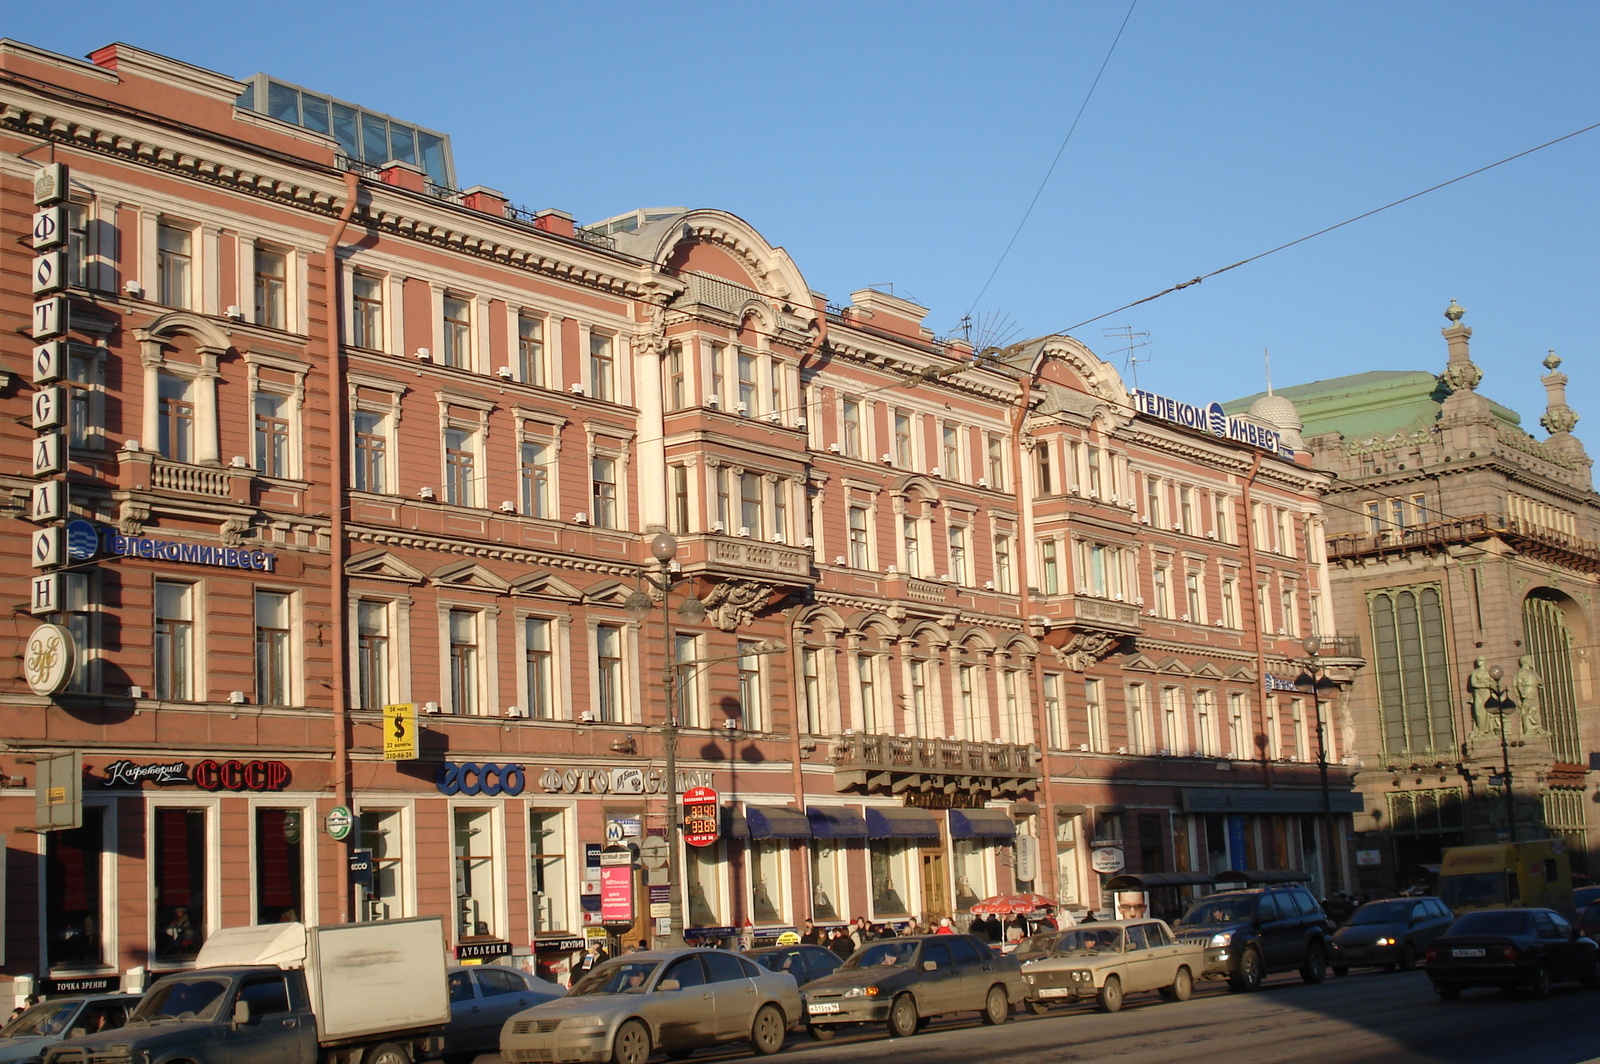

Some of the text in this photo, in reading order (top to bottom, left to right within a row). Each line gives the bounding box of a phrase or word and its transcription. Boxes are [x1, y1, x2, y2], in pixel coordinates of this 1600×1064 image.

[1135, 389, 1280, 452] ТЕЛЕКОМ ИНВЕСТ
[101, 528, 275, 571] Телекоминвест
[103, 760, 287, 790] Кафетерий СССР
[436, 761, 525, 797] ecco
[538, 768, 609, 794] ФОТО
[608, 827, 620, 839] М
[461, 944, 508, 958] ДУБЛЕНКИ
[57, 980, 107, 991] ТОЧКА ЗРЕНИЯ
